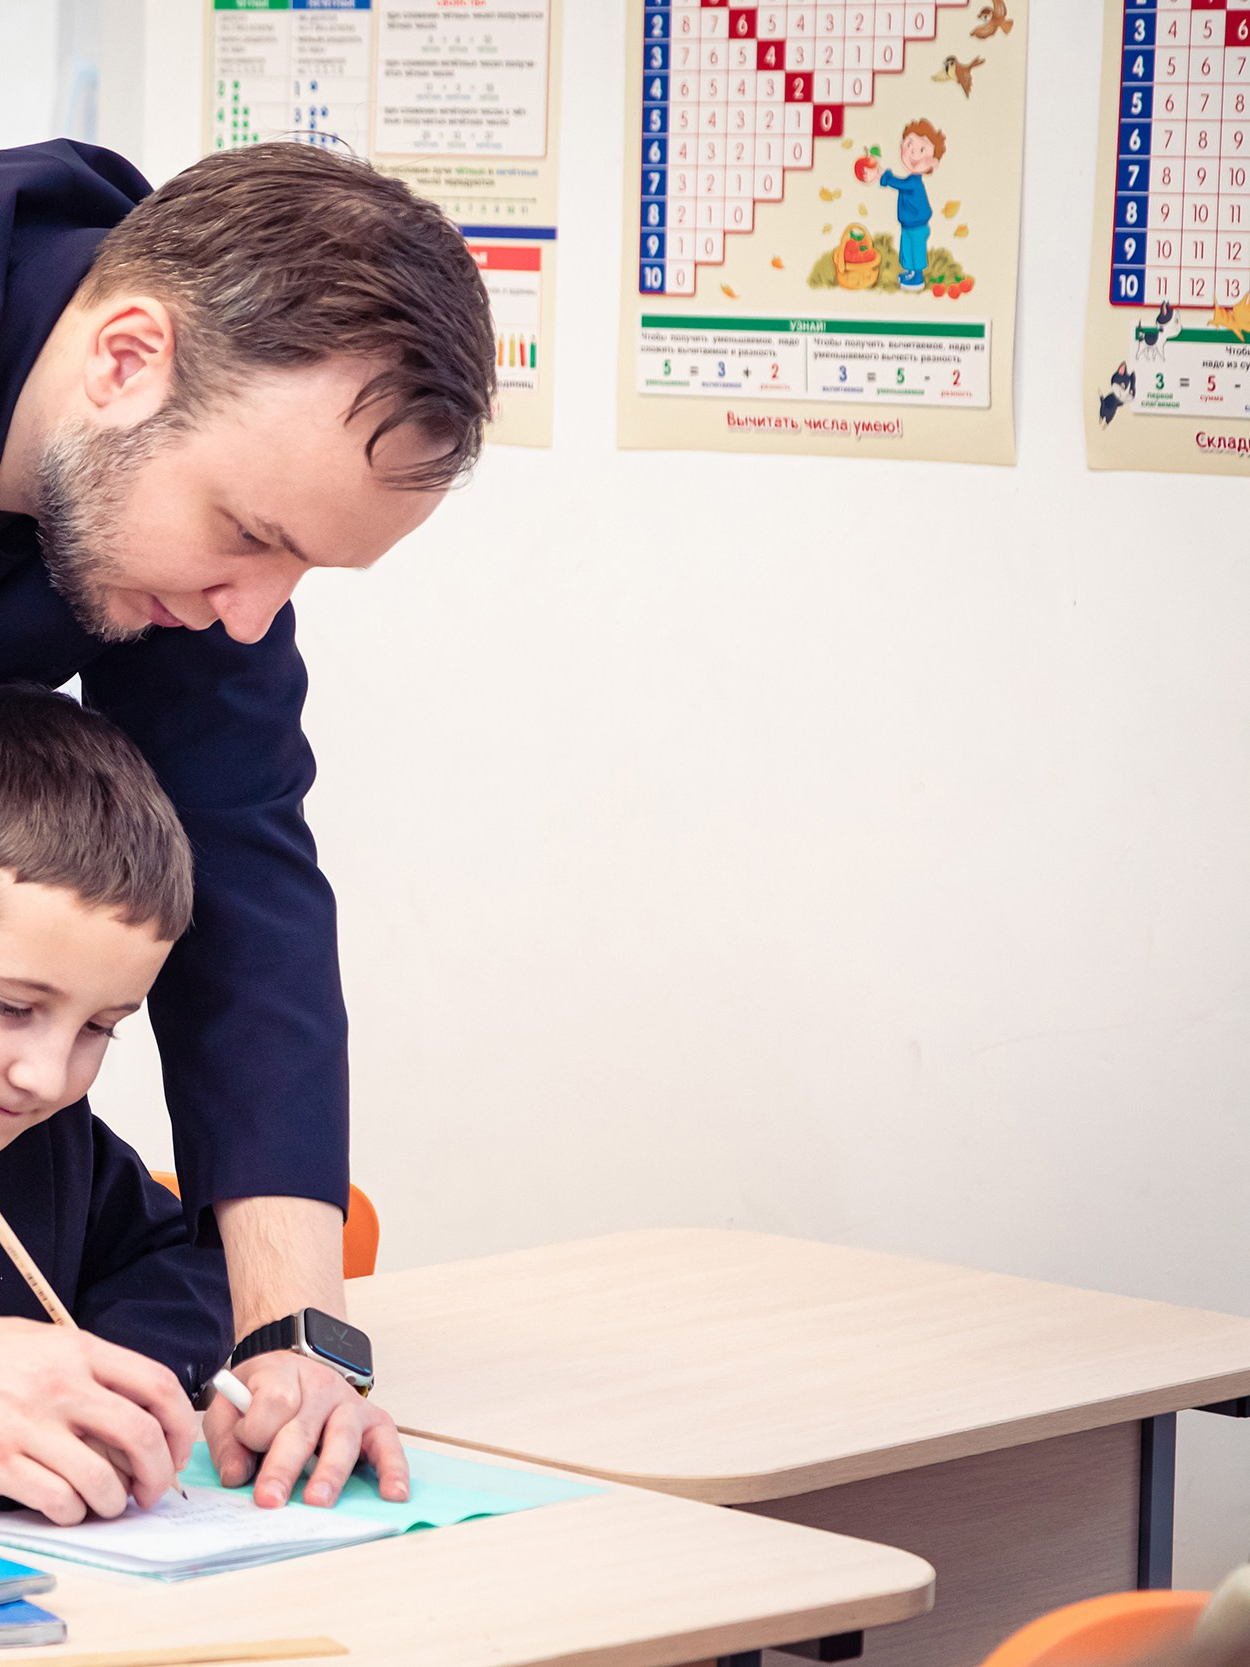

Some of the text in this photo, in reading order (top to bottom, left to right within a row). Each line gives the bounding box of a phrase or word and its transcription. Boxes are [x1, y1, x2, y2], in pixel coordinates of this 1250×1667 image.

[651, 14, 663, 37] 2
[681, 15, 691, 34] 8
[710, 14, 719, 34] 7
[736, 14, 748, 36] 6
[767, 14, 777, 33] 5
[796, 14, 805, 32] 4
[825, 13, 835, 32] 3
[855, 12, 864, 32] 2
[914, 12, 925, 31] 0
[1134, 18, 1249, 41] 3 4 5 6
[652, 47, 662, 68] 3
[681, 46, 690, 66] 7
[709, 47, 719, 65] 6
[738, 46, 747, 65] 5
[764, 45, 776, 67] 4
[795, 46, 805, 65] 3
[824, 45, 834, 65] 2
[883, 45, 893, 64] 0
[1133, 56, 1247, 77] 4 5 6 7
[650, 78, 662, 99] 4
[680, 79, 690, 97] 6
[709, 78, 718, 97] 5
[737, 79, 746, 97] 4
[766, 78, 775, 97] 3
[793, 77, 804, 100] 2
[852, 78, 863, 96] 0
[1131, 92, 1245, 114] 5 6 7 8
[651, 110, 661, 131] 5
[680, 110, 689, 129] 5
[707, 111, 717, 128] 4
[736, 110, 746, 129] 3
[765, 110, 775, 130] 2
[821, 109, 833, 132] 0
[1130, 129, 1244, 151] 6 7 8 9
[649, 141, 660, 162] 6
[678, 142, 687, 160] 4
[707, 141, 716, 161] 3
[735, 142, 745, 161] 2
[792, 142, 803, 161] 0
[650, 172, 660, 193] 7
[678, 173, 687, 192] 3
[706, 173, 716, 193] 2
[763, 174, 773, 193] 0
[1129, 165, 1246, 187] 7 8 9 10
[648, 204, 659, 225] 8
[677, 205, 687, 225] 2
[733, 206, 744, 224] 0
[1126, 201, 1241, 224] 8 9 10 11
[648, 235, 659, 256] 9
[704, 237, 714, 255] 0
[1125, 238, 1242, 261] 9 10 11 12
[644, 265, 686, 287] 10 0
[1120, 275, 1240, 298] 10 11 12 13
[789, 319, 827, 332] УЗНАЙ!
[663, 359, 672, 376] 5
[718, 361, 726, 378] 3
[771, 363, 779, 379] 2
[839, 365, 847, 382] 3
[897, 367, 905, 384] 5
[952, 369, 961, 386] 2
[1155, 373, 1164, 390] 3
[1207, 375, 1216, 392] 5
[727, 411, 902, 437] Вычитать числа умею!
